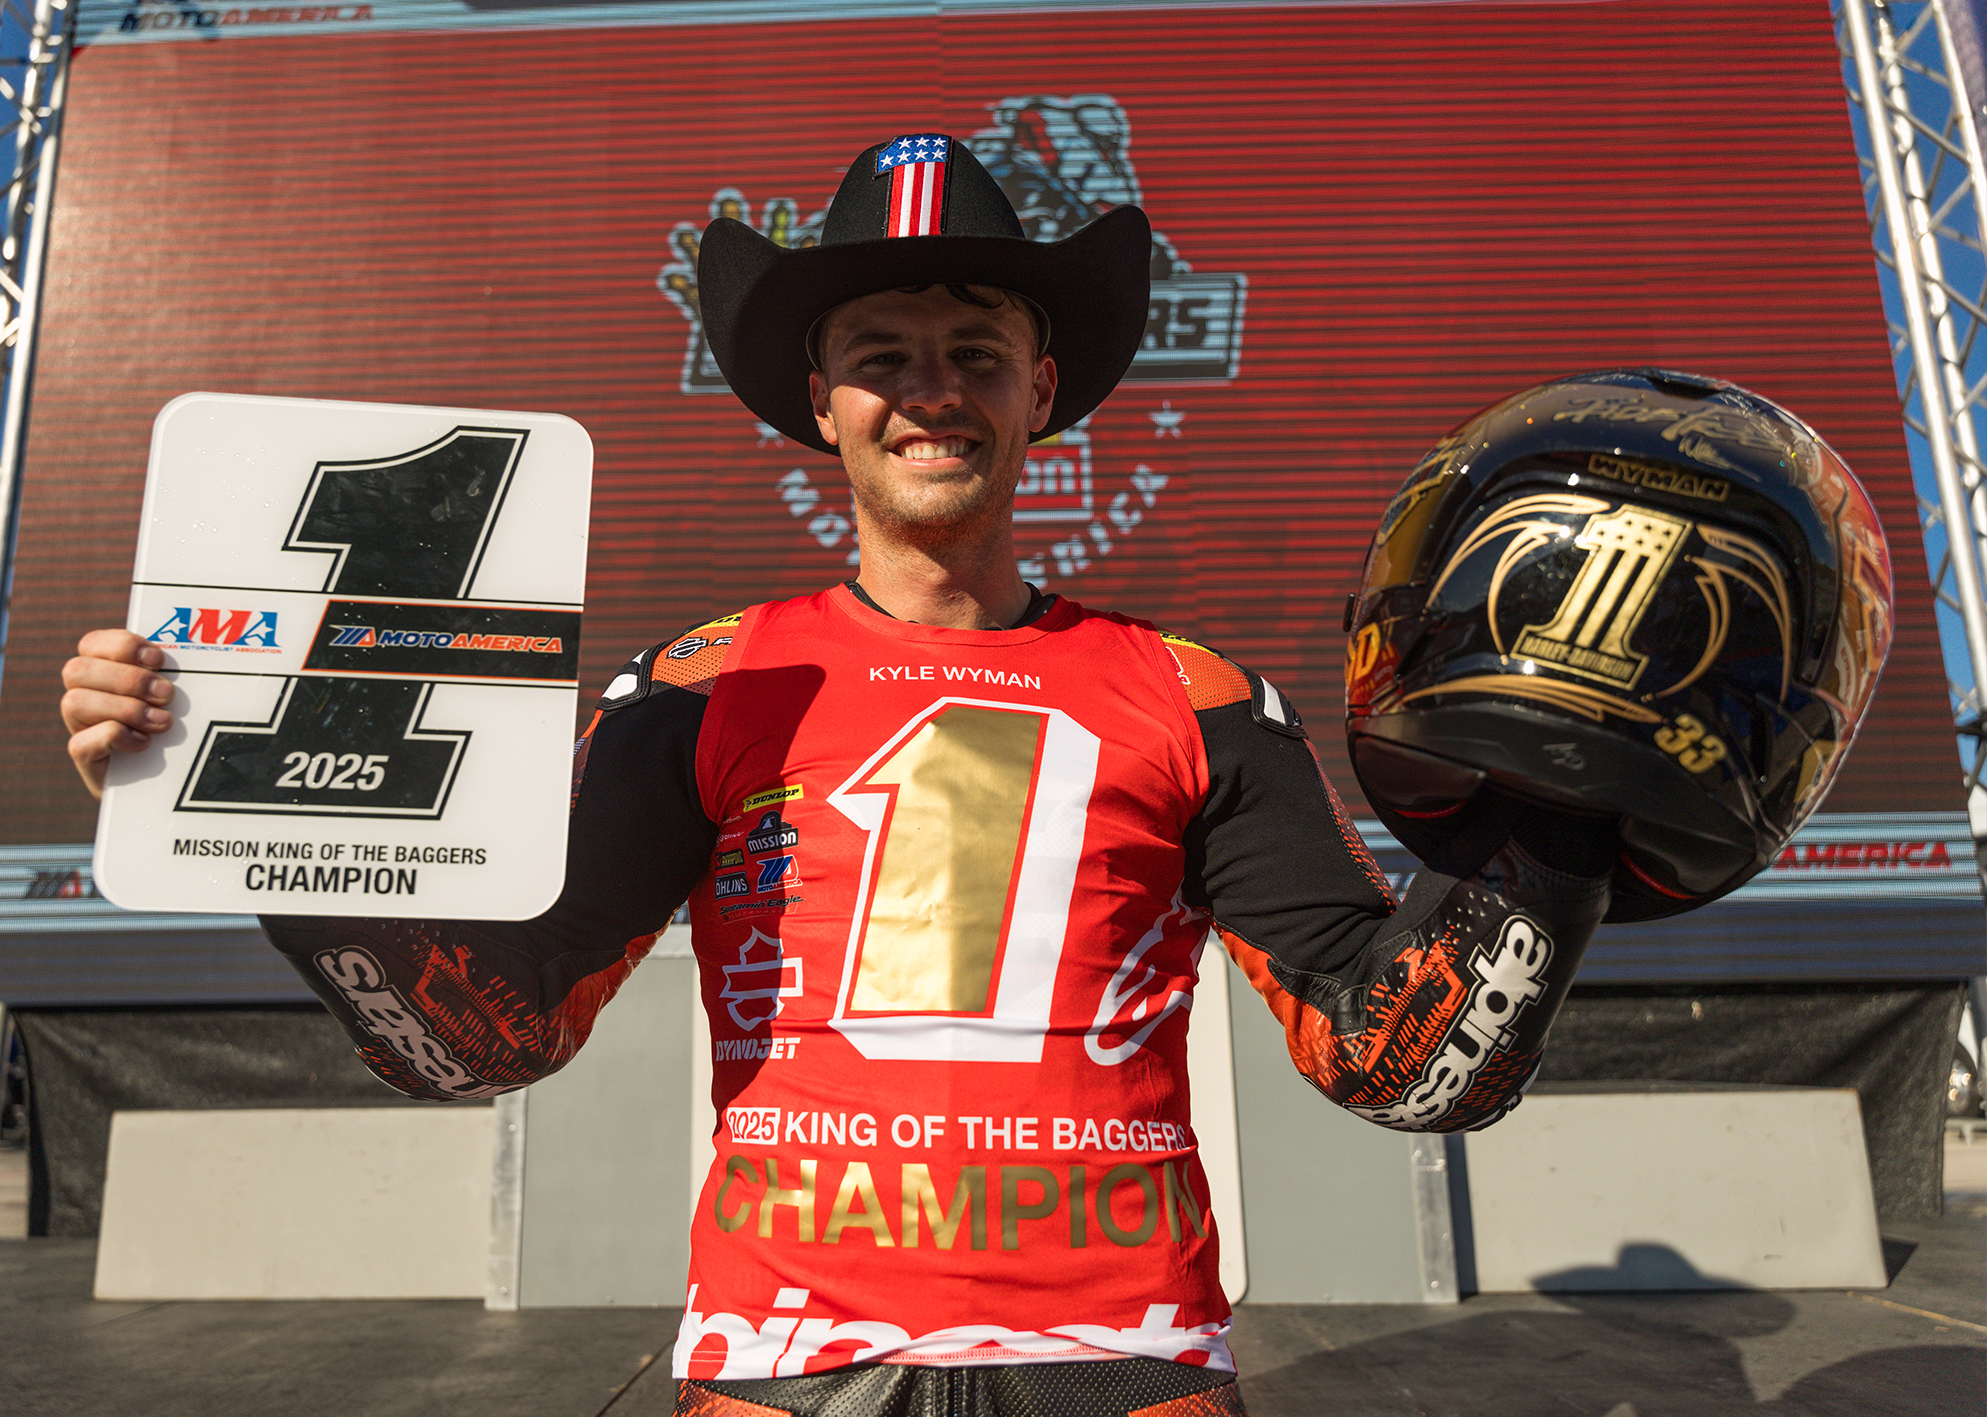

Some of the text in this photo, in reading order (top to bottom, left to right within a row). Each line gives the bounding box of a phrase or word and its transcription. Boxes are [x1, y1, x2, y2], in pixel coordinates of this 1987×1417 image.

[118, 4, 374, 32] MOTOAMERICA
[1588, 453, 1730, 501] WYMAN
[147, 606, 284, 648] AMA
[173, 425, 531, 821] 1
[179, 644, 234, 652] MOTORCYCLIST
[377, 629, 563, 654] MOTOAMERICA
[869, 666, 1041, 690] KYLE WYMAN
[1653, 712, 1727, 774] 33
[275, 751, 390, 791] 2025
[751, 788, 800, 806] DUNLOP
[173, 839, 487, 865] MISSION KING OF THE BAGGERS
[747, 831, 797, 853] mission
[245, 863, 418, 895] CHAMPION
[826, 696, 1101, 1063] 1
[715, 1037, 802, 1063] DYNOJET
[728, 1110, 1190, 1151] 2025 KING OF THE BAGGERS
[714, 1155, 1209, 1251] CHAMPION
